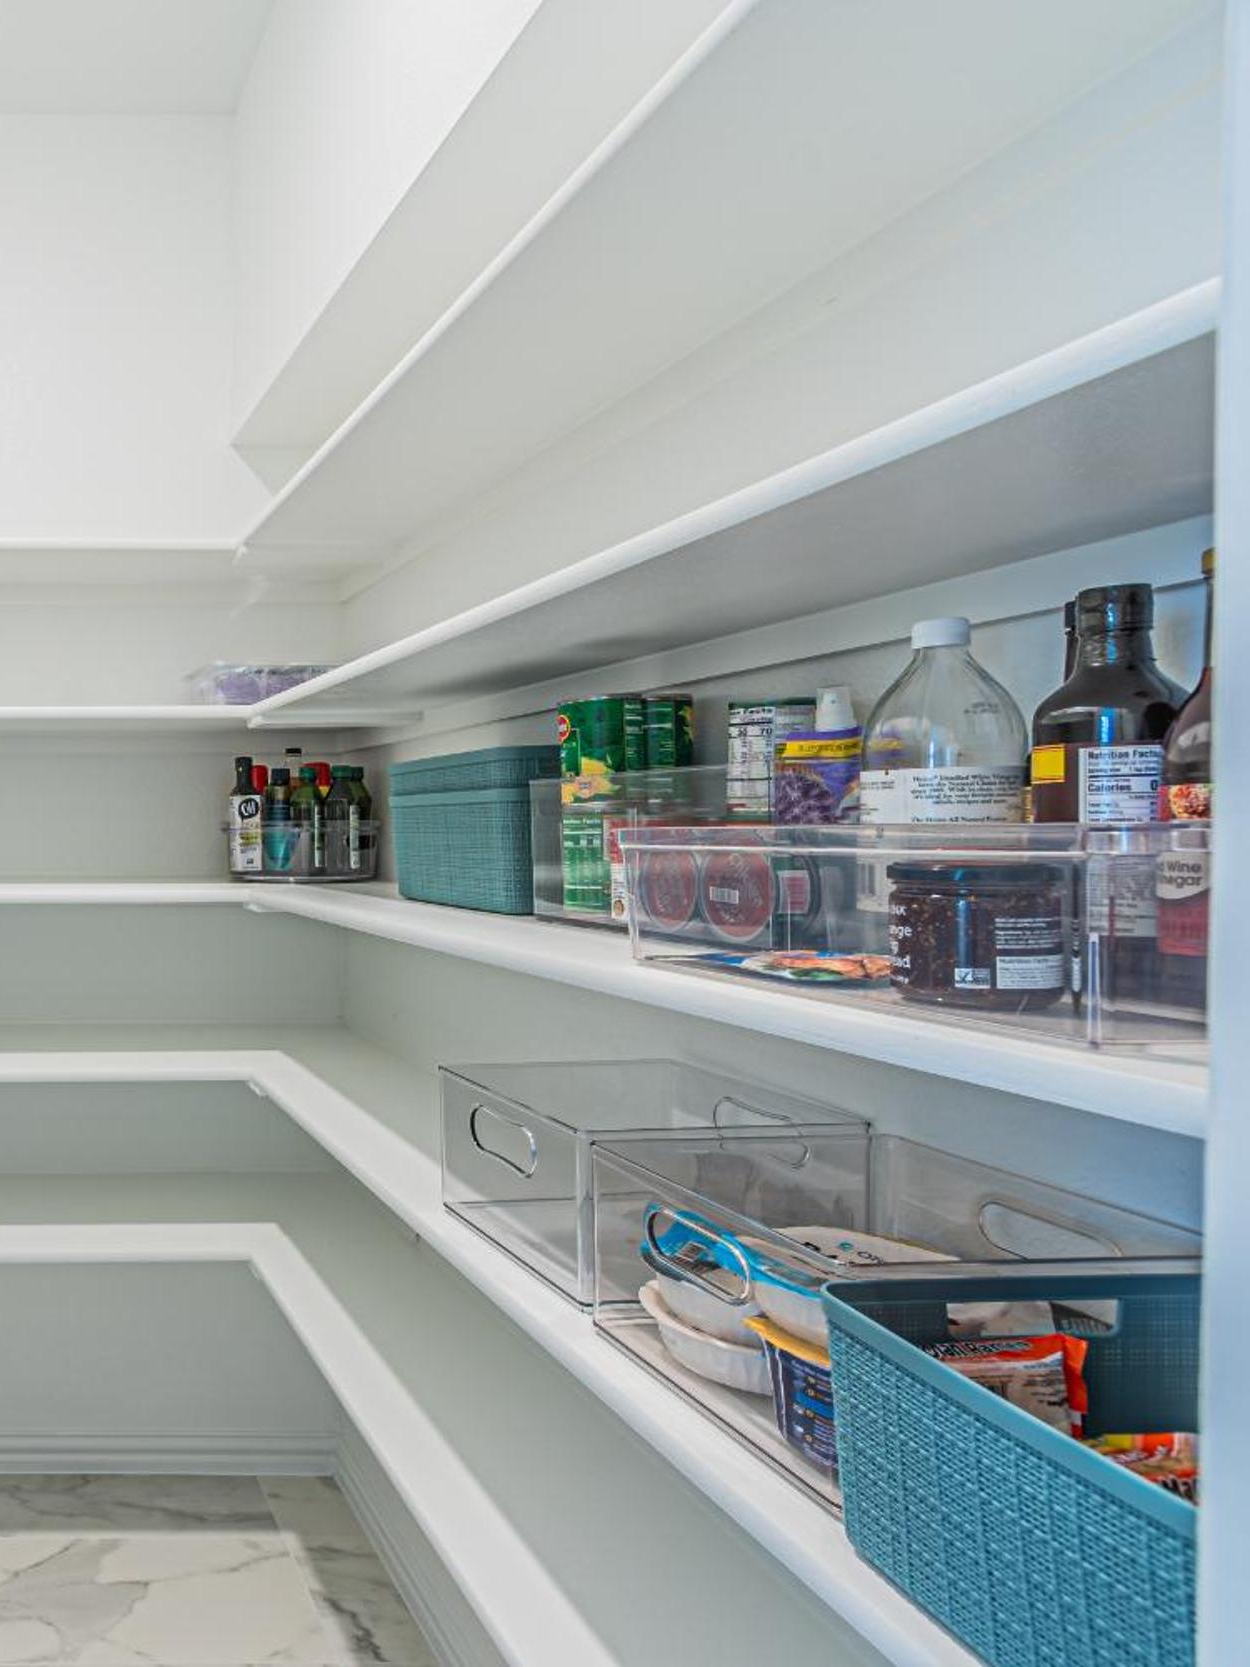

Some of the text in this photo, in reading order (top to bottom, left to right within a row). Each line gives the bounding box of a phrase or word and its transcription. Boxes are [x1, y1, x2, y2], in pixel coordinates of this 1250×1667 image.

[1088, 782, 1131, 792] Calories
[1167, 860, 1202, 873] Wine
[1158, 875, 1203, 889] negar
